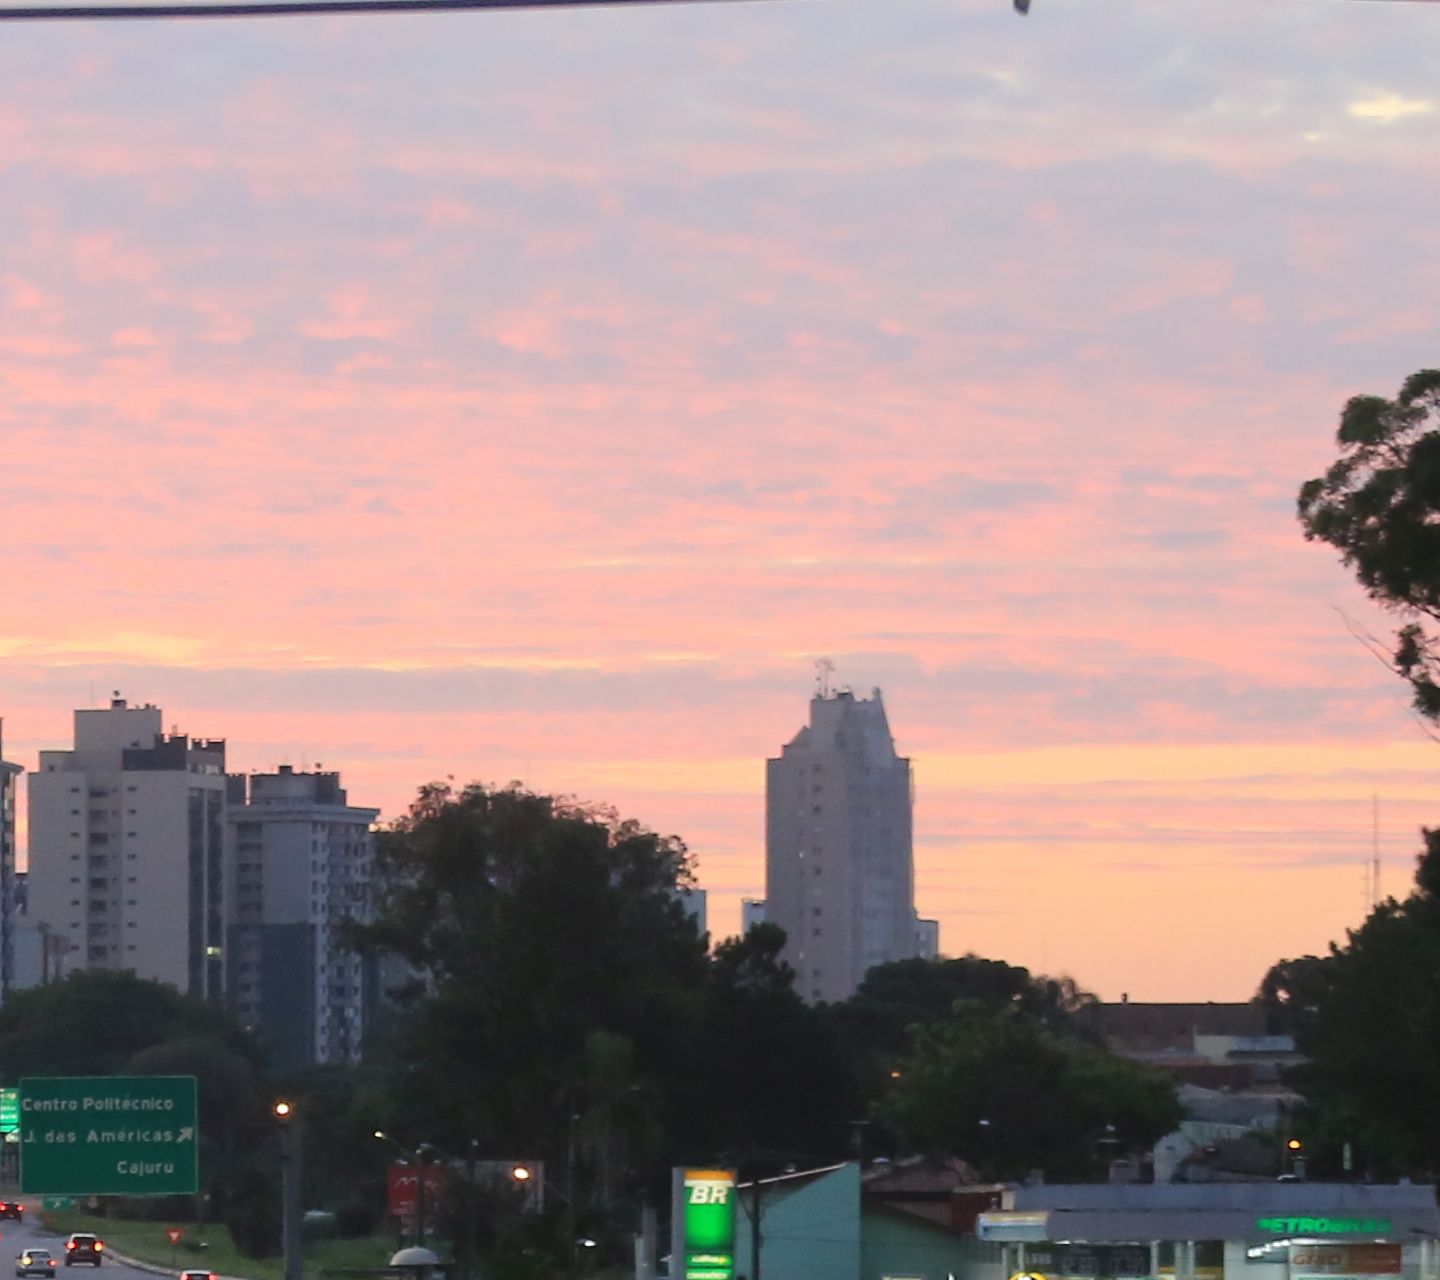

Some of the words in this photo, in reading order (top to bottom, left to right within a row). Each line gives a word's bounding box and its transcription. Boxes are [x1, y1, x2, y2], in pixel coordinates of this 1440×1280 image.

[22, 1098, 78, 1111] Centro
[83, 1095, 174, 1111] Politécnico
[45, 1129, 76, 1143] das
[86, 1127, 173, 1143] Américas
[116, 1161, 174, 1177] Cajuru
[688, 1185, 729, 1205] BR
